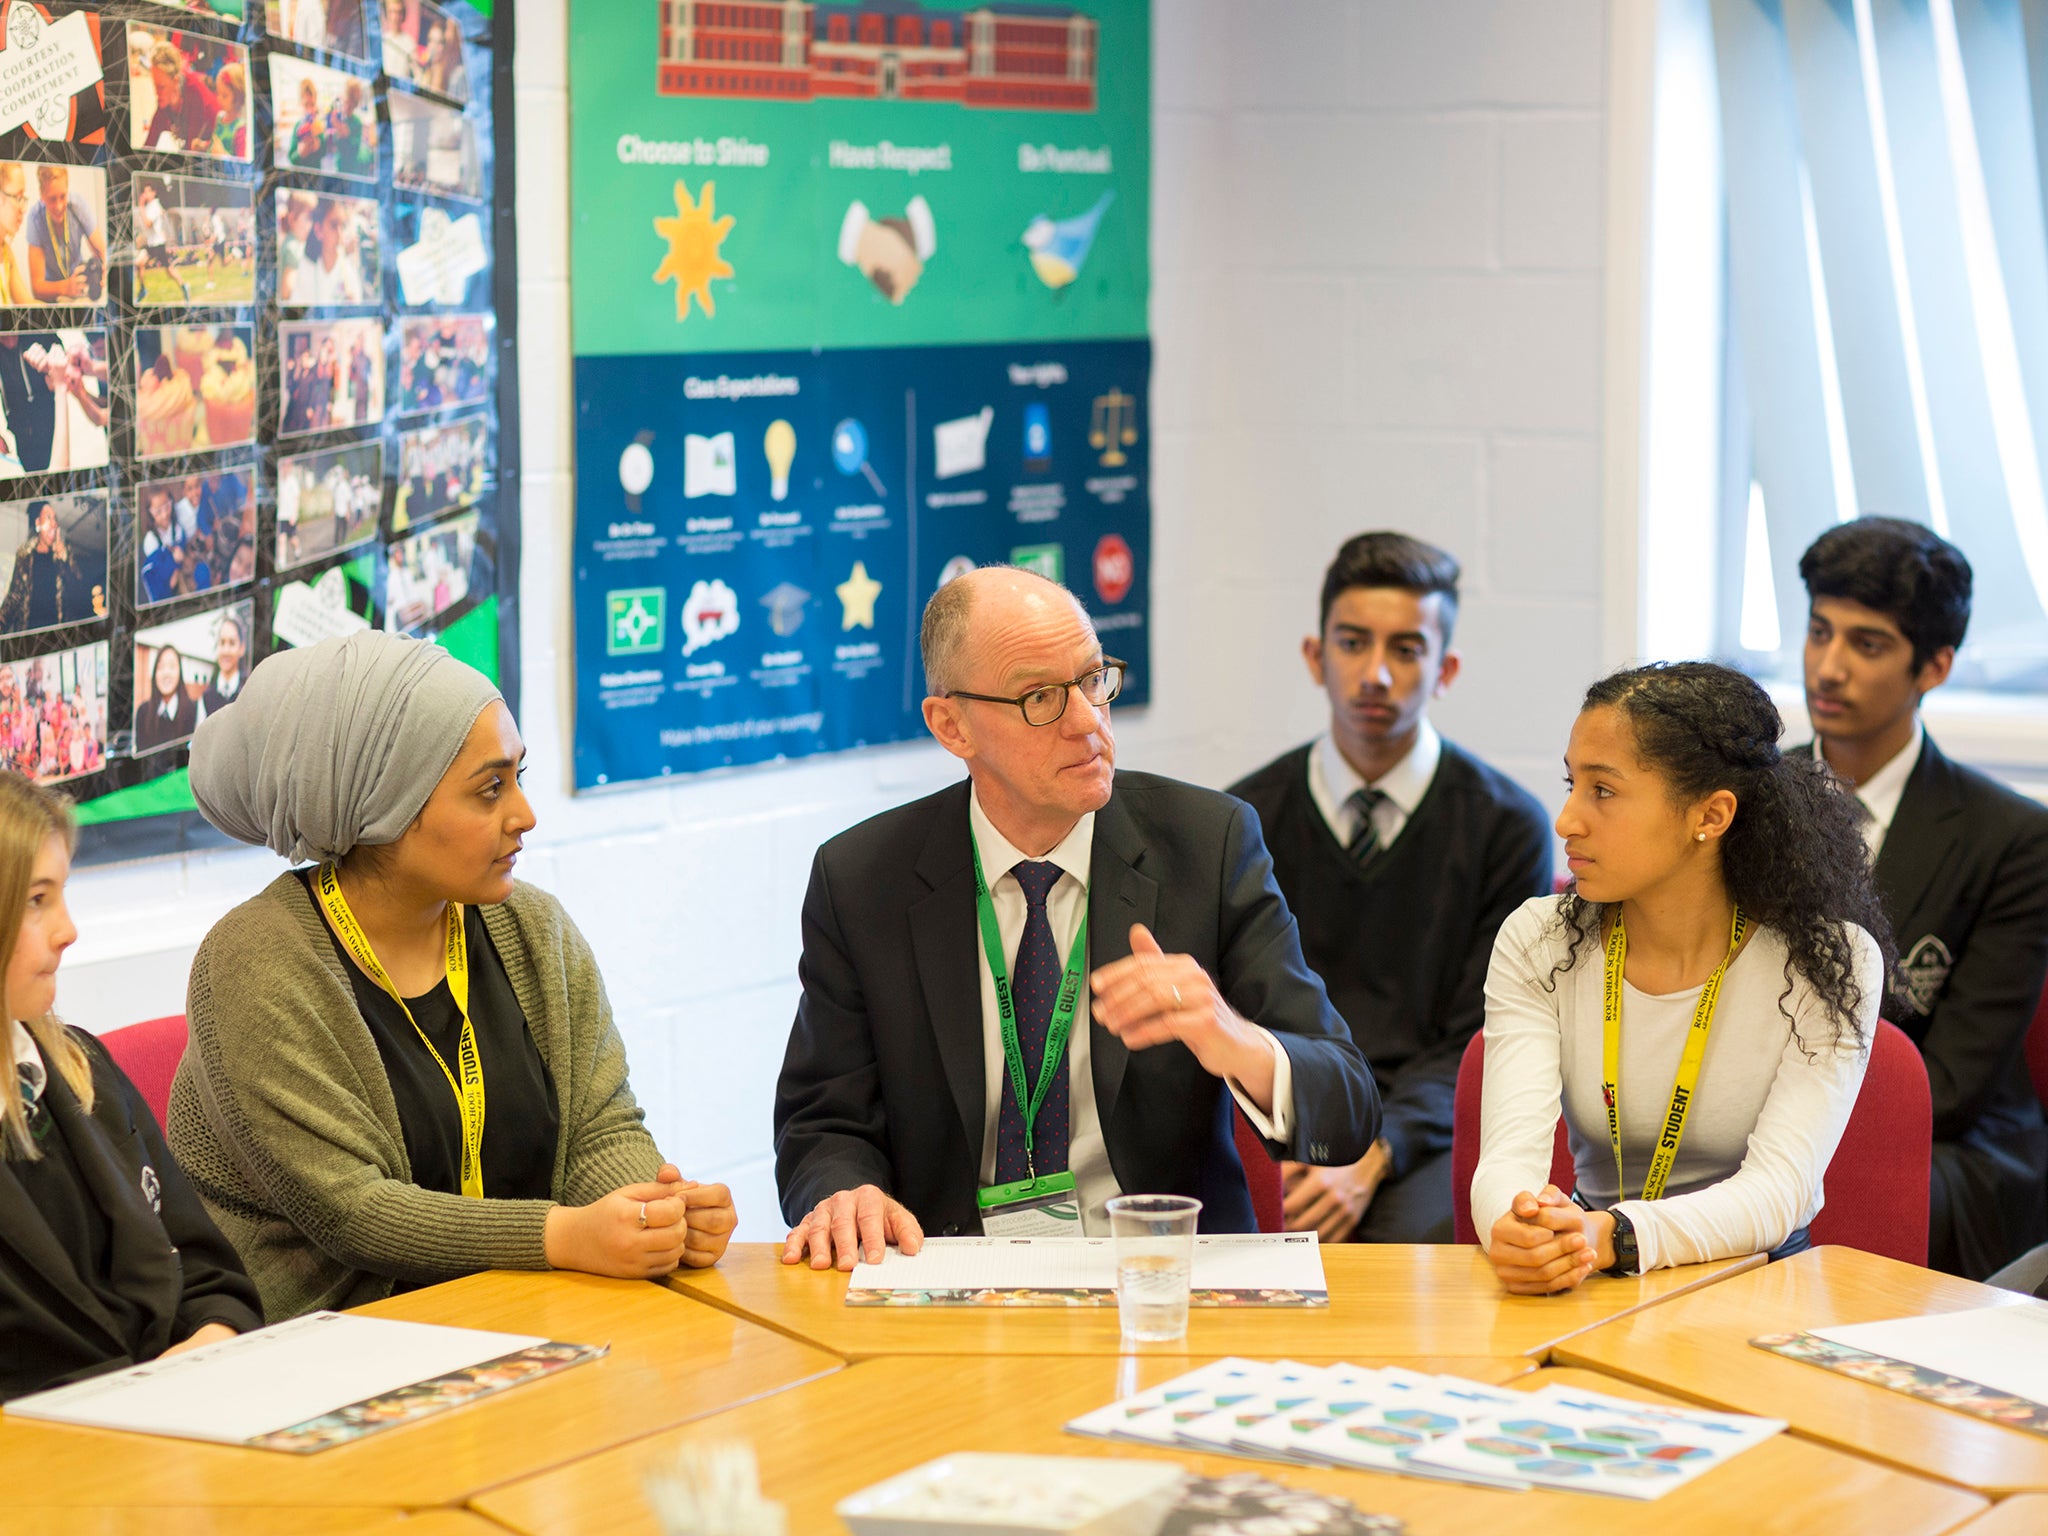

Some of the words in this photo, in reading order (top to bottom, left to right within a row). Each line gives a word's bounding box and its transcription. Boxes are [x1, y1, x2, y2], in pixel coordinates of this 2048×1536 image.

[2, 42, 60, 80] COURTESY
[1, 66, 79, 116] COMMITMENT
[616, 134, 692, 164] Choose
[694, 137, 715, 165] to
[716, 136, 769, 167] Shine
[828, 140, 876, 169] Have
[327, 899, 350, 934] SCHOOL
[448, 926, 456, 972] ROUNDHAY
[1607, 931, 1620, 968] SCHOOL
[995, 975, 1012, 1020] GUEST
[1059, 969, 1080, 1013] GUEST
[1694, 978, 1715, 1029] ROUNDHAY
[1002, 1023, 1014, 1060] SCHOOL
[1048, 1017, 1062, 1053] SCHOOL
[461, 1026, 479, 1086] STUDENT
[466, 1090, 477, 1129] SCHOOL
[1661, 1085, 1690, 1150] STUDENT
[1648, 1152, 1666, 1190] SCHOOL
